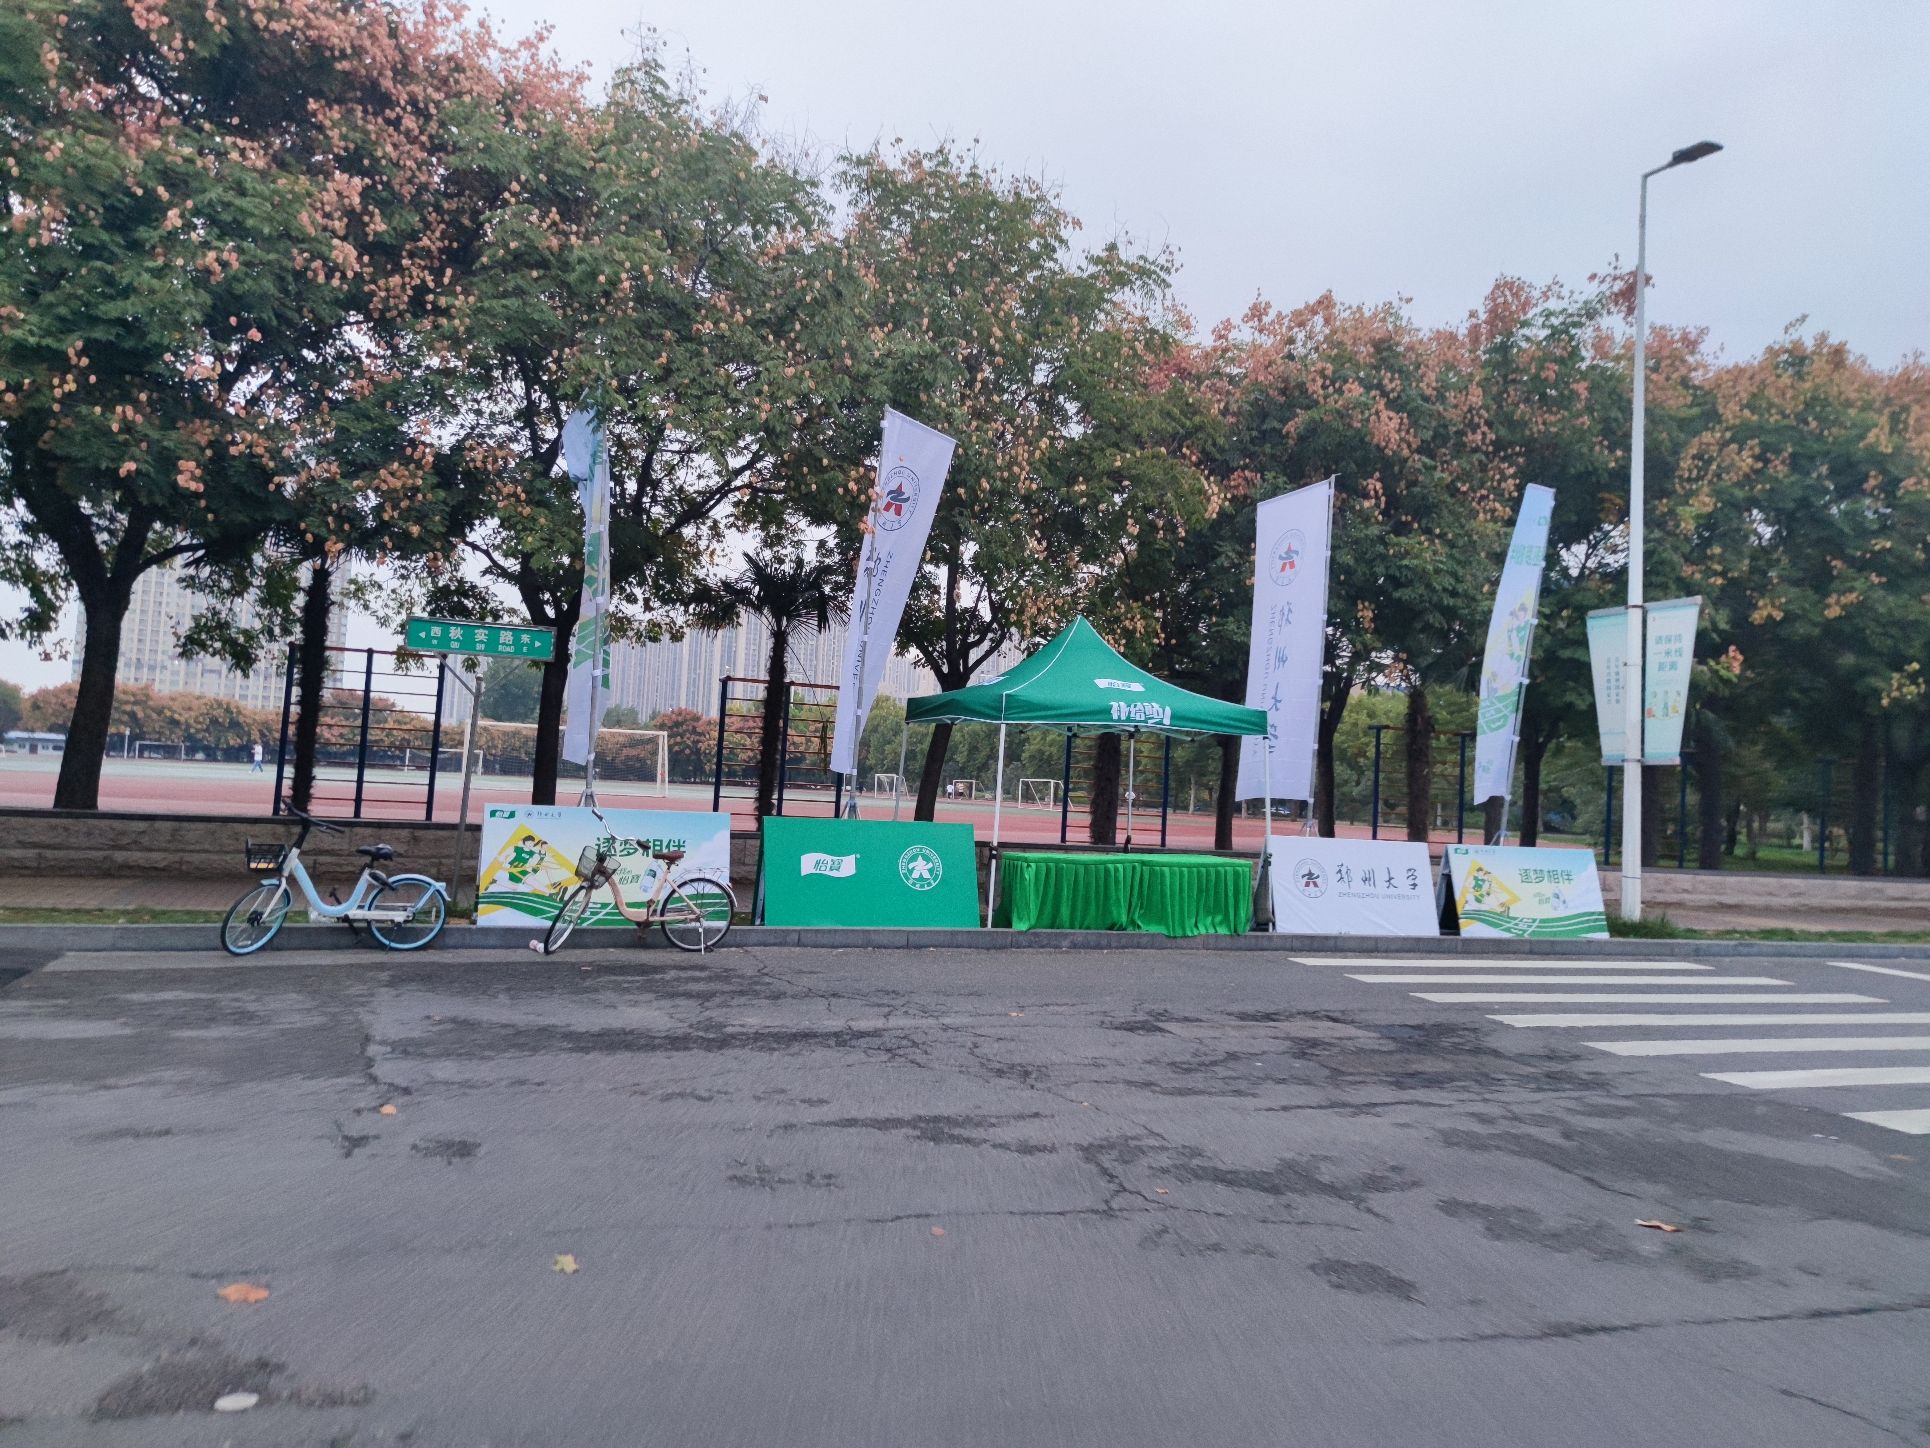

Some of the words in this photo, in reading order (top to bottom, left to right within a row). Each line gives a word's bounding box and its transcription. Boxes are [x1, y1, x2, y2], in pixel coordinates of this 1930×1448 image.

[430, 626, 442, 637] 西
[449, 626, 513, 644] 秋实路
[520, 633, 531, 643] 东
[498, 645, 515, 653] ROAD
[1335, 862, 1418, 890] 郑州大学
[1338, 891, 1379, 899] ZHENGZHOU
[1381, 893, 1421, 901] UNIVERSITY
